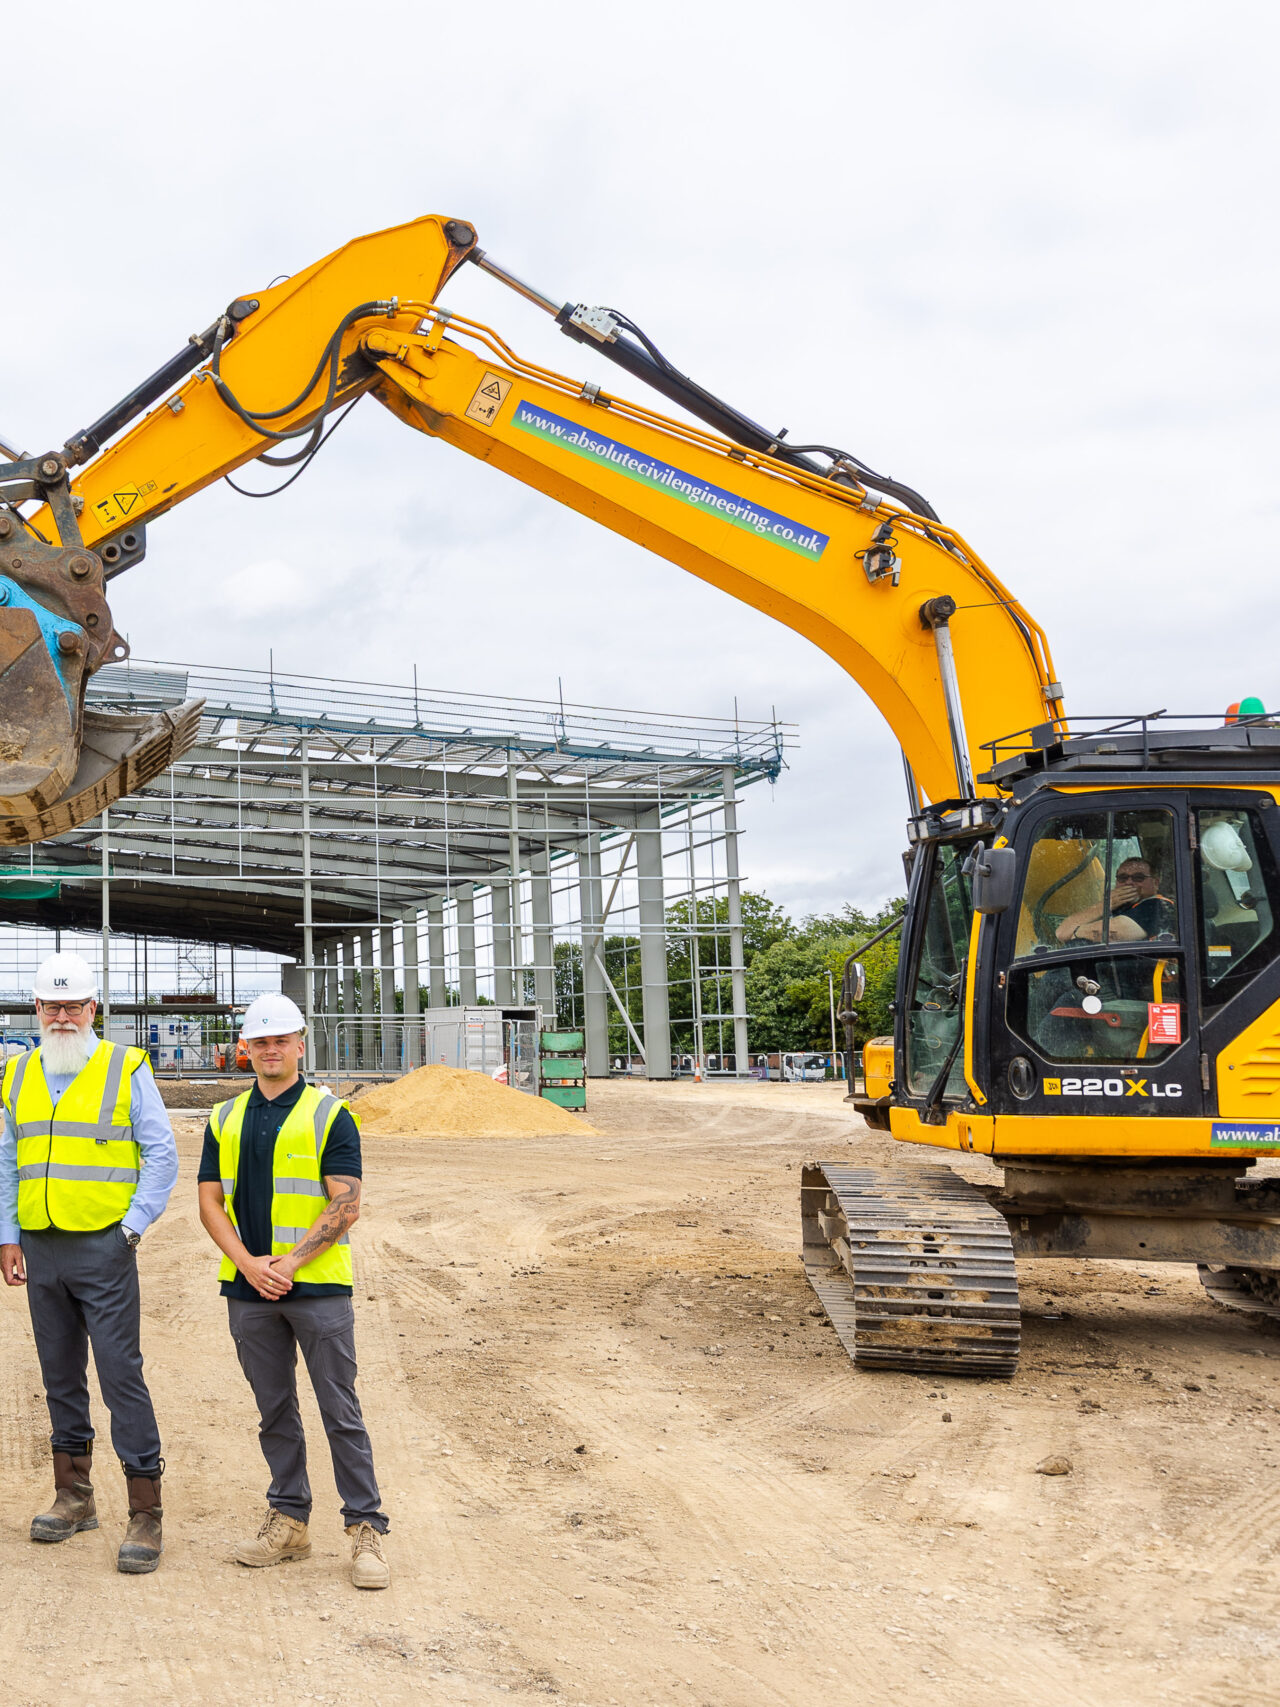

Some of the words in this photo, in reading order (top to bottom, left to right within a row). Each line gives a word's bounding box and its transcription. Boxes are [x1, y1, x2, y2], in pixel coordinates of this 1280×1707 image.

[520, 409, 822, 553] www.absolutecivilengineering.co.uk
[54, 978, 68, 986] UK
[1151, 1083, 1183, 1098] LC
